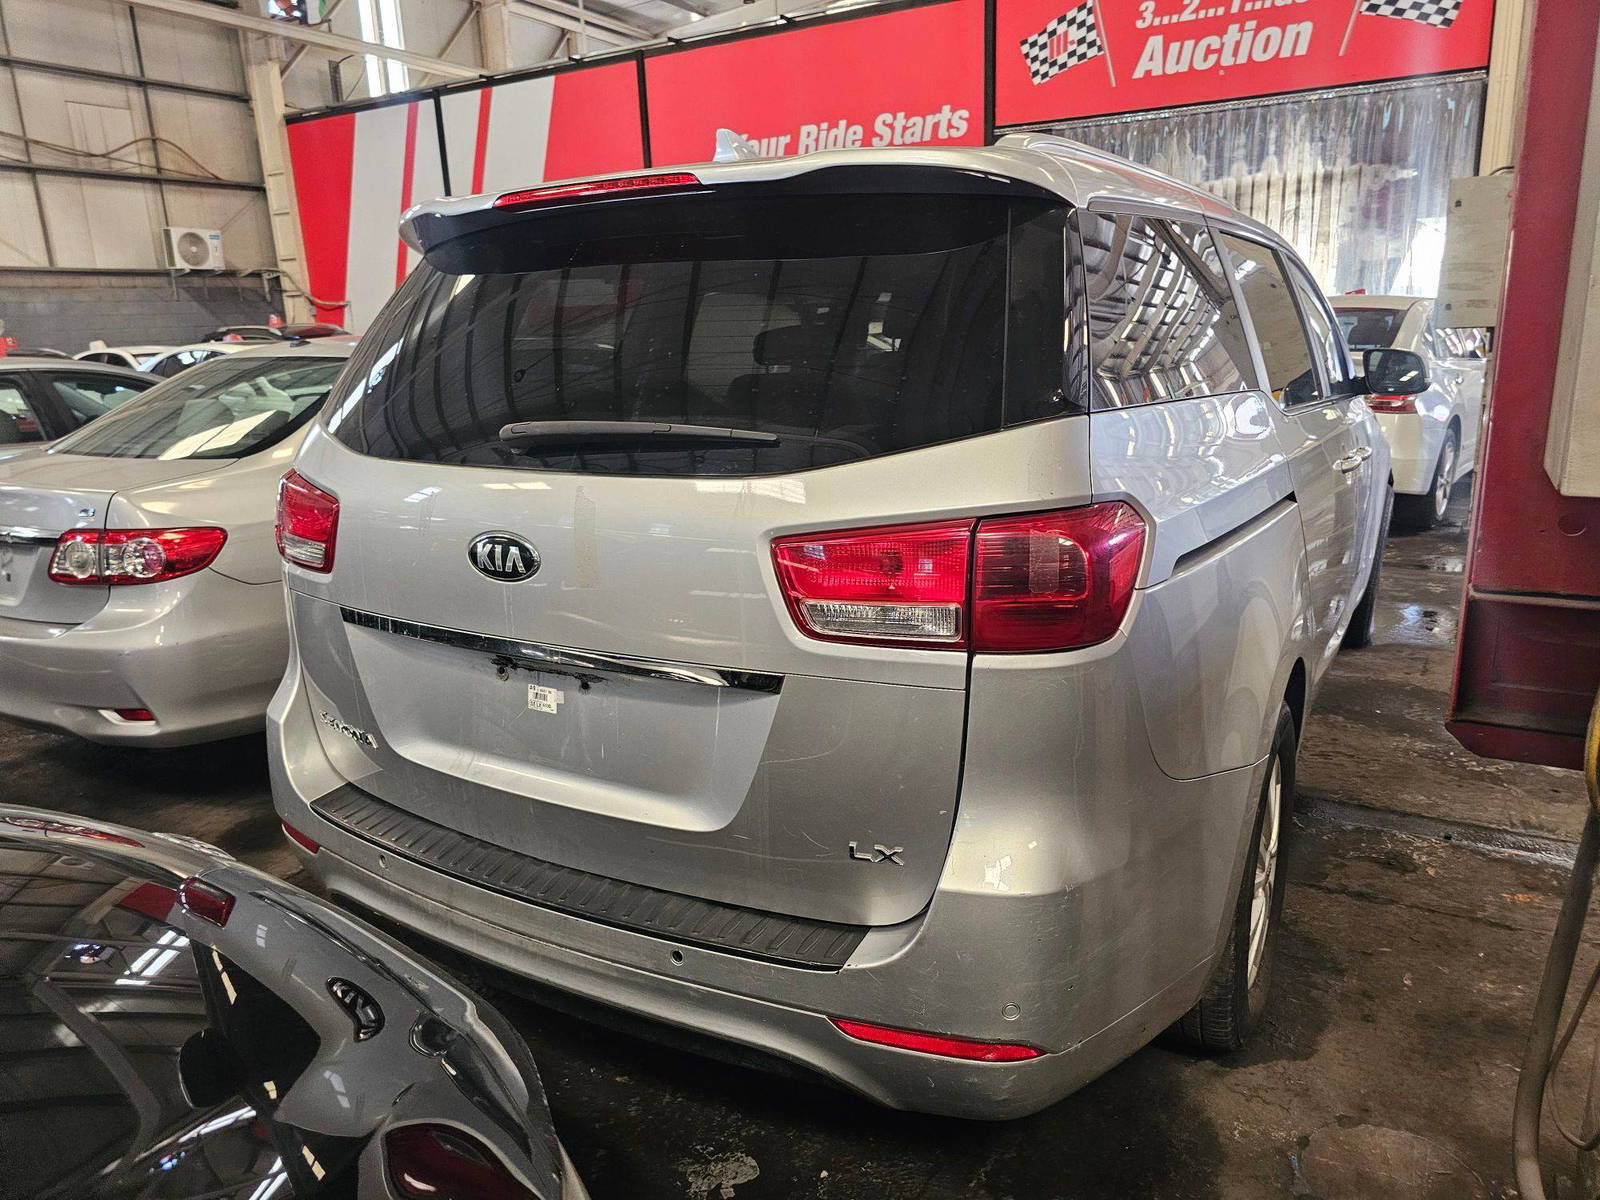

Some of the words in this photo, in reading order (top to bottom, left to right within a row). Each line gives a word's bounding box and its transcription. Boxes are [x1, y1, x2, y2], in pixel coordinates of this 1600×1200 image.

[1131, 20, 1314, 79] Auction
[739, 133, 791, 158] our
[798, 119, 864, 155] Ride
[872, 104, 970, 147] Starts
[476, 541, 526, 574] KIA
[849, 841, 904, 866] LX
